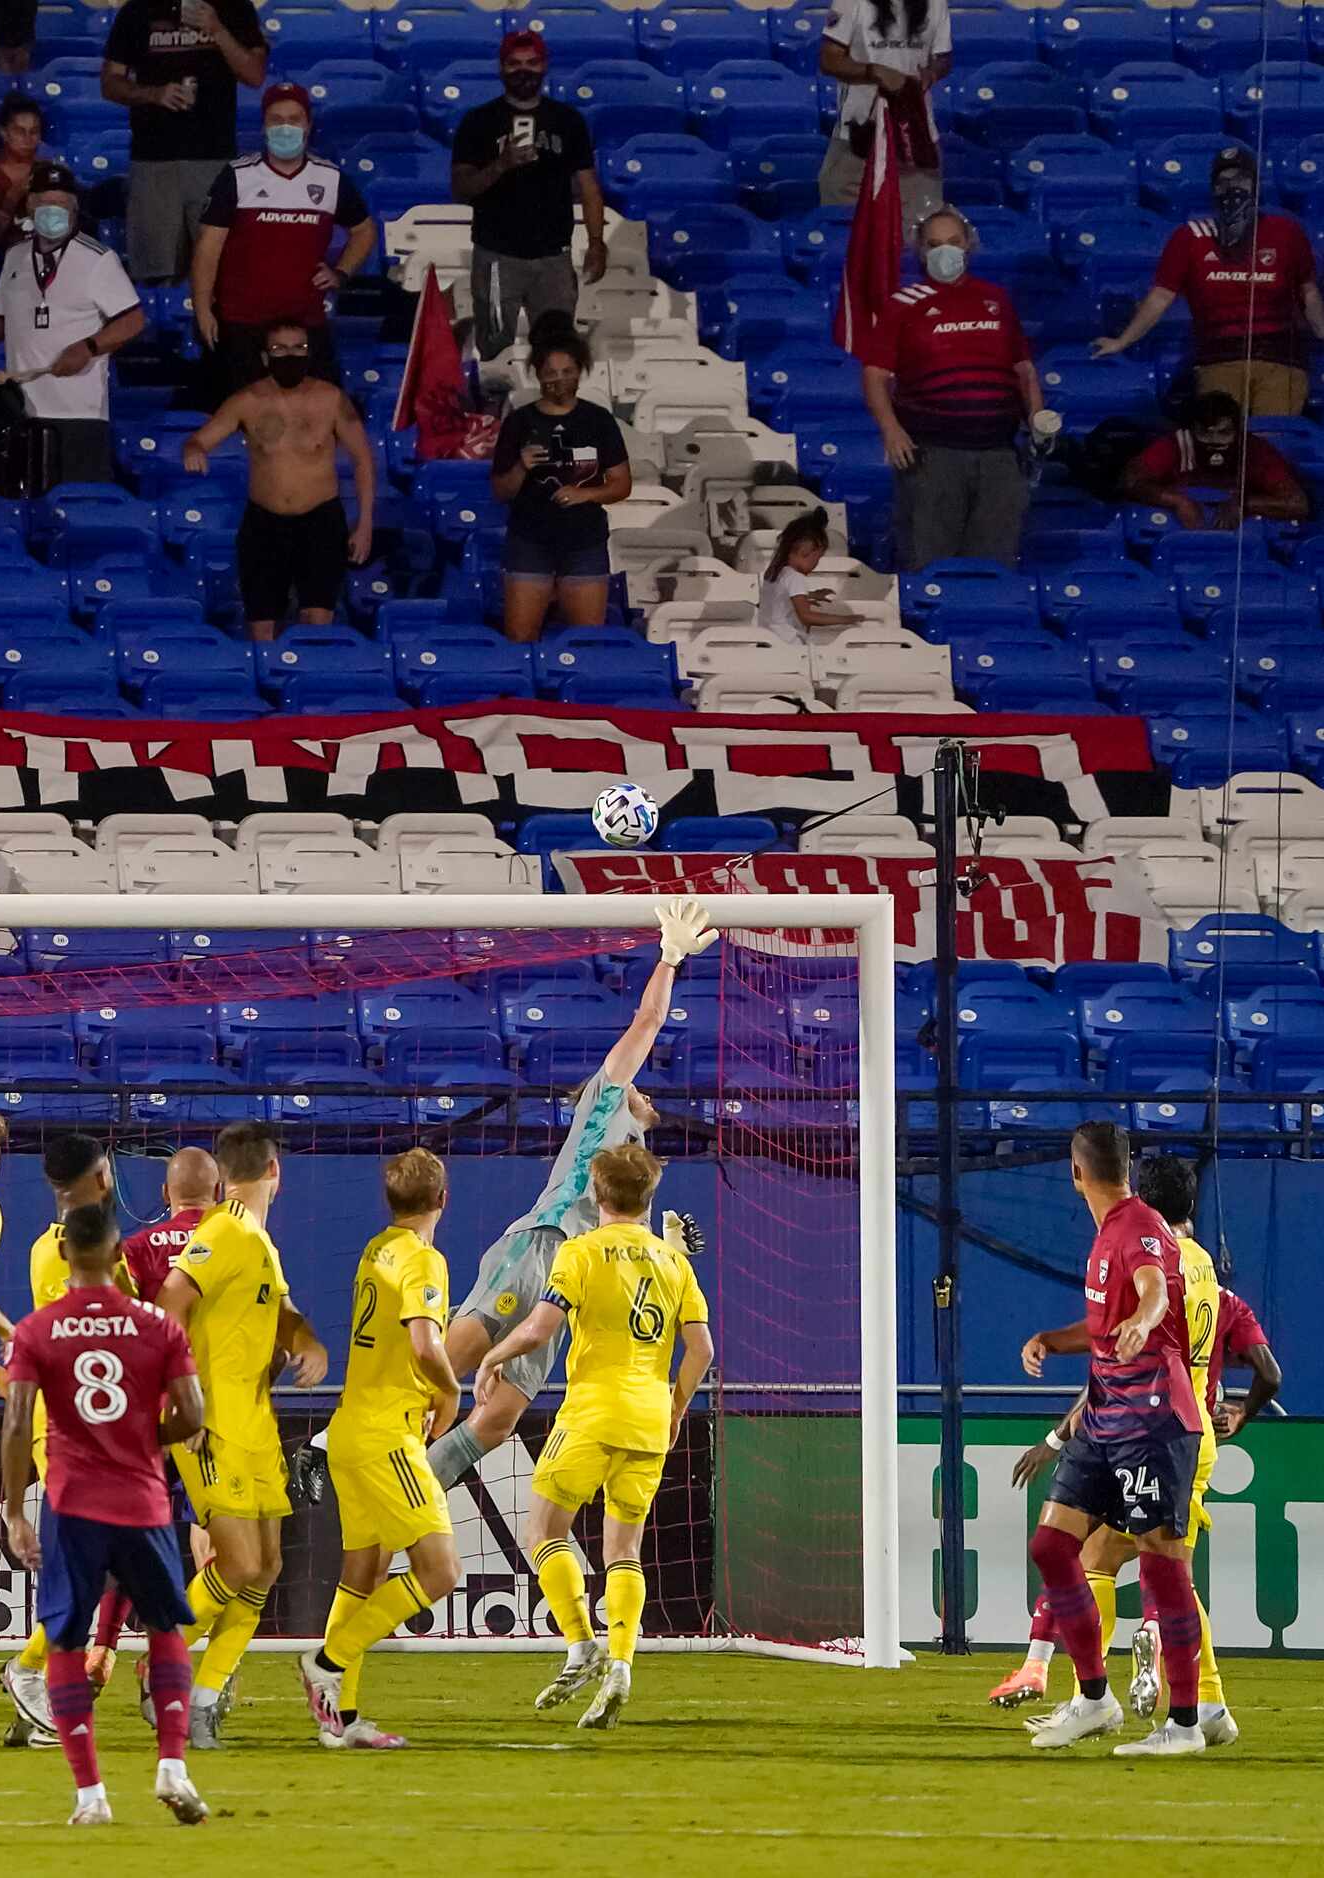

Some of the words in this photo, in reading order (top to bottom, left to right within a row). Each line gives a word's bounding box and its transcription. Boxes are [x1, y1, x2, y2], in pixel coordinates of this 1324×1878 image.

[256, 211, 321, 225] ADVOCARE
[1205, 271, 1277, 282] ADVOCARE
[932, 320, 1001, 334] ADVOCARE
[628, 1275, 665, 1345] 6
[50, 1315, 139, 1340] ACOSTA
[72, 1349, 129, 1425] 8
[1114, 1465, 1161, 1503] 24
